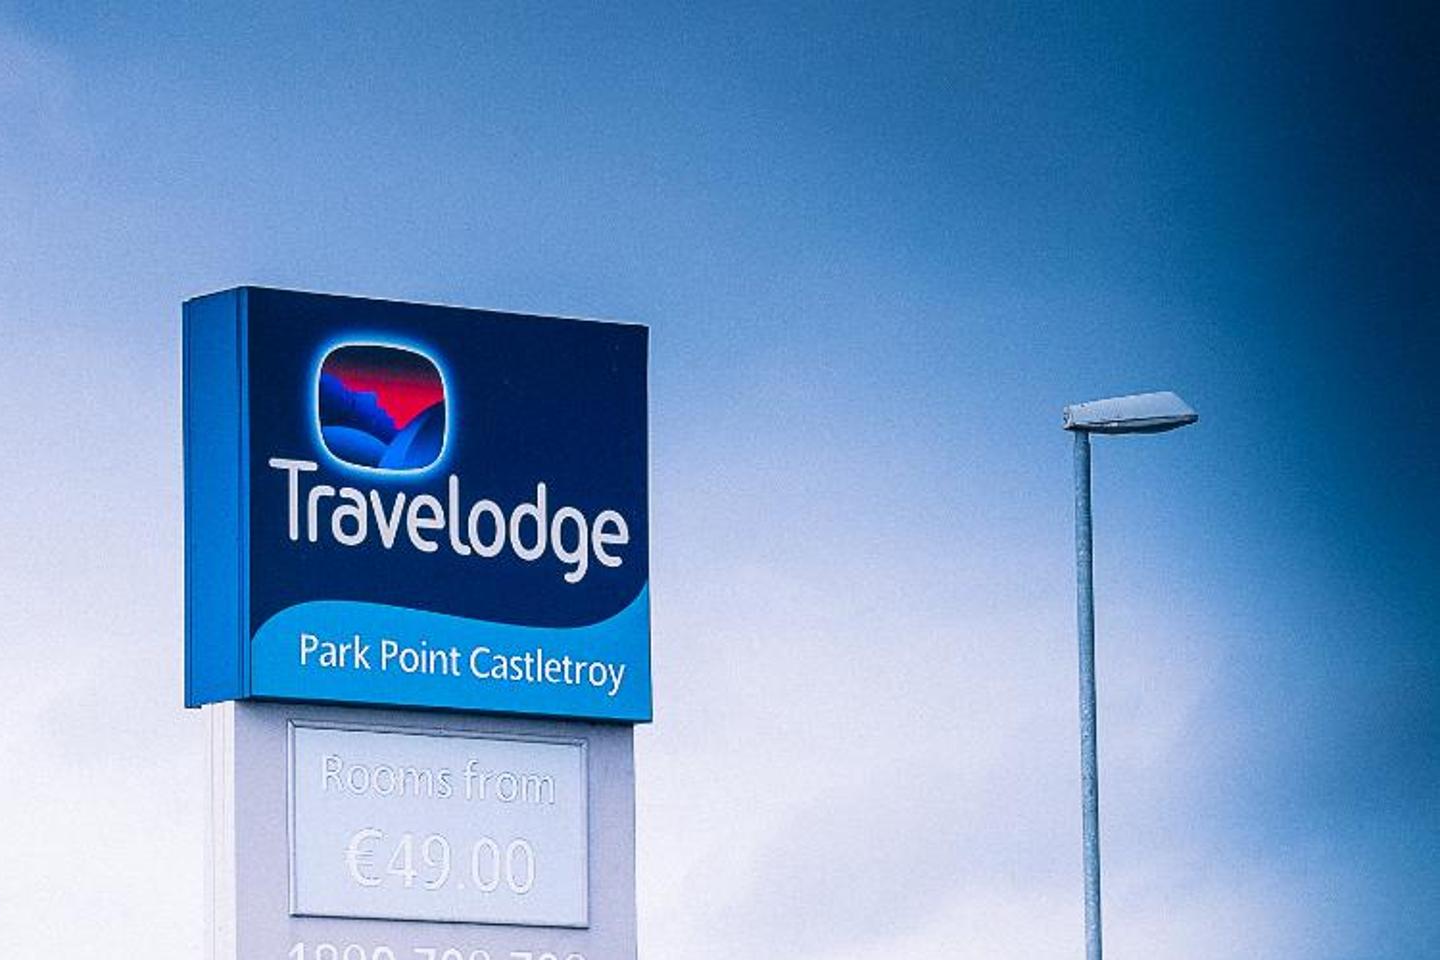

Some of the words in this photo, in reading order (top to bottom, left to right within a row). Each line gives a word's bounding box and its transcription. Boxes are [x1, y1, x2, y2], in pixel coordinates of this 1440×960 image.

[269, 458, 629, 584] Travelodge
[299, 633, 371, 671] Park
[381, 639, 461, 677] Point
[469, 646, 626, 696] Castletroy
[321, 753, 453, 800] Rooms
[463, 758, 556, 805] from
[343, 826, 536, 896] €49.00
